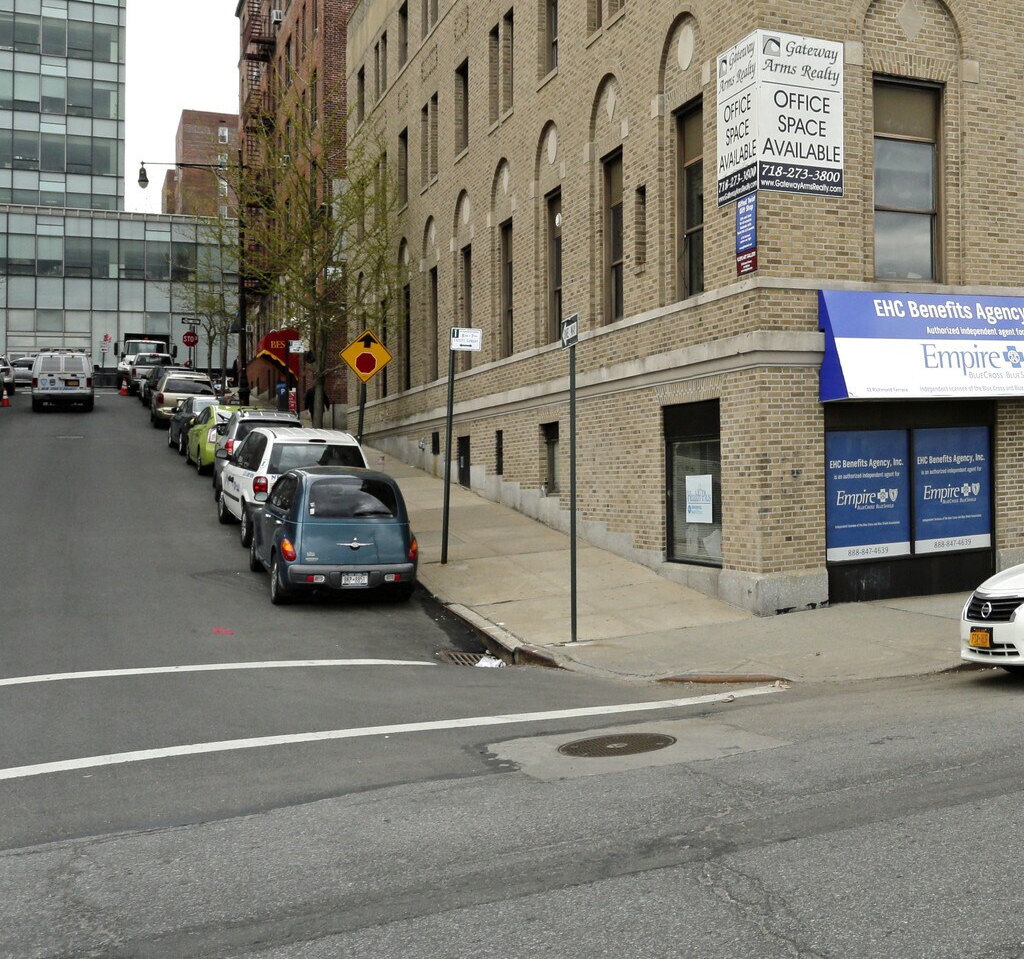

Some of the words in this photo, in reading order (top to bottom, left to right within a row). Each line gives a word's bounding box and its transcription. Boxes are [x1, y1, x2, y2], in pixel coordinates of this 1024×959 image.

[786, 40, 839, 65] Gateway
[762, 58, 797, 76] Arms
[800, 64, 841, 87] Realty
[724, 93, 751, 123] OFFICE
[773, 89, 831, 114] OFFICE
[726, 118, 749, 146] SPACE
[778, 114, 827, 138] SPACE
[719, 139, 756, 173] AVAILABLE
[762, 137, 841, 163] AVAILABLE
[761, 163, 841, 183] 718-273-3800
[760, 179, 843, 193] www.GatewayArmsRealty.com
[873, 299, 906, 318] EHC
[907, 300, 973, 320] Benefits
[926, 326, 960, 335] Authorized
[960, 327, 997, 336] independent
[998, 328, 1015, 337] agent
[1015, 328, 1024, 336] for
[270, 340, 286, 349] BES
[920, 343, 1001, 376] Empire
[829, 459, 842, 469] EHC
[842, 458, 868, 468] Benefits
[868, 458, 892, 469] Agency,
[893, 457, 904, 466] Inc.
[917, 456, 929, 465] EHC
[929, 454, 952, 464] Benefits
[953, 454, 975, 465] Agency,
[975, 453, 985, 461] Inc.
[836, 488, 876, 509] Empire
[923, 483, 960, 502] Empire
[847, 546, 889, 557] 888-847-4639
[933, 538, 972, 549] 888-847-4639
